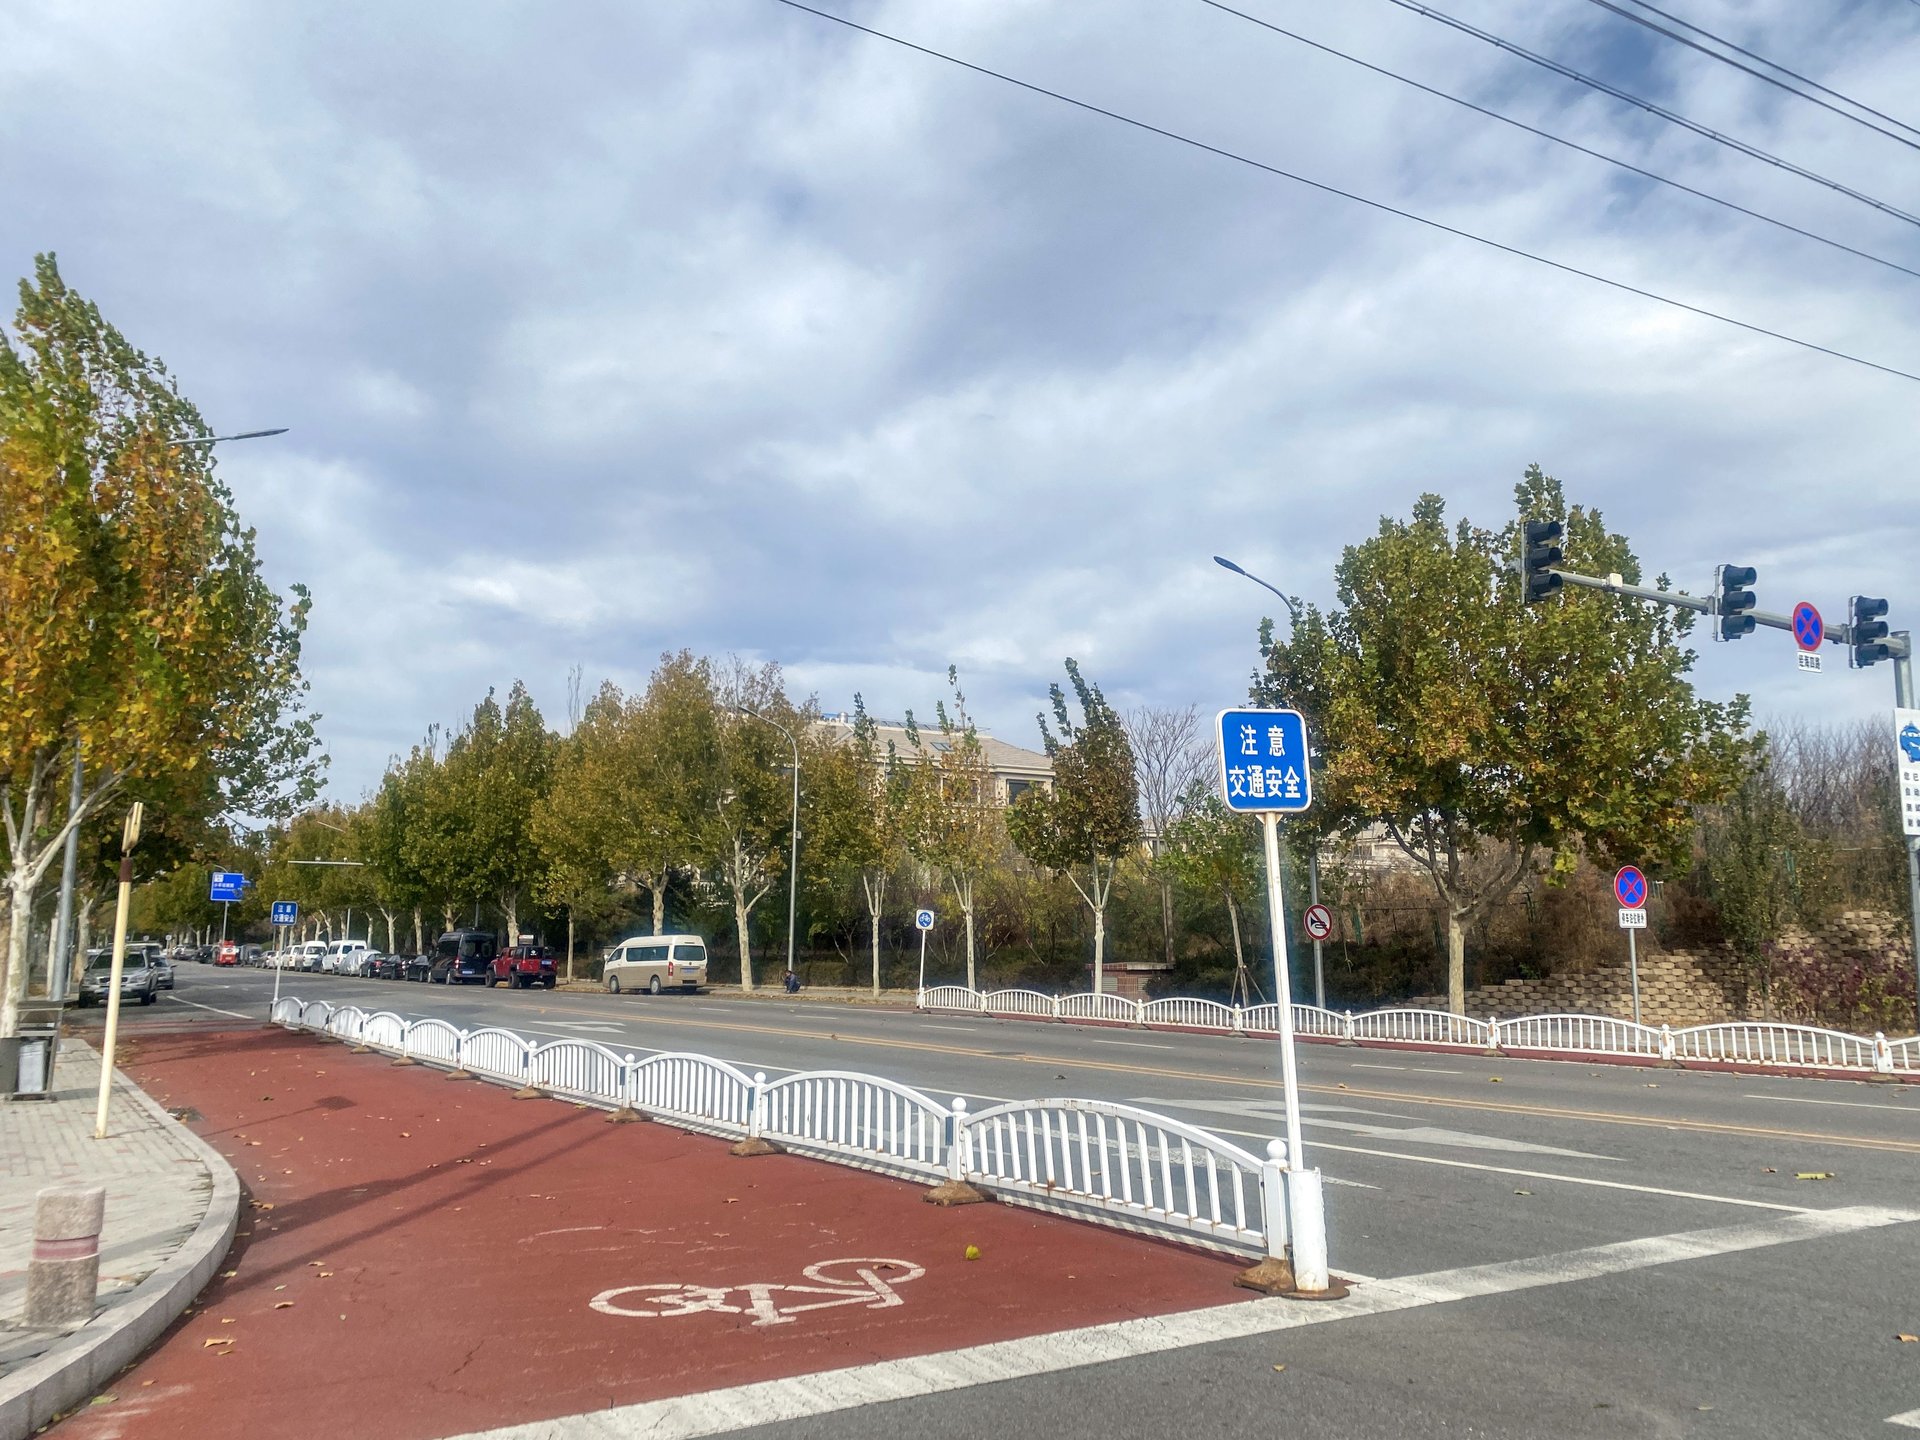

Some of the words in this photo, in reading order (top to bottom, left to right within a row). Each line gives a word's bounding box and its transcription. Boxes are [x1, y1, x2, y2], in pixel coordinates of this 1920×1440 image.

[1239, 724, 1286, 757] 注意
[1228, 764, 1301, 798] 交通安全
[273, 914, 295, 923] 交通安全
